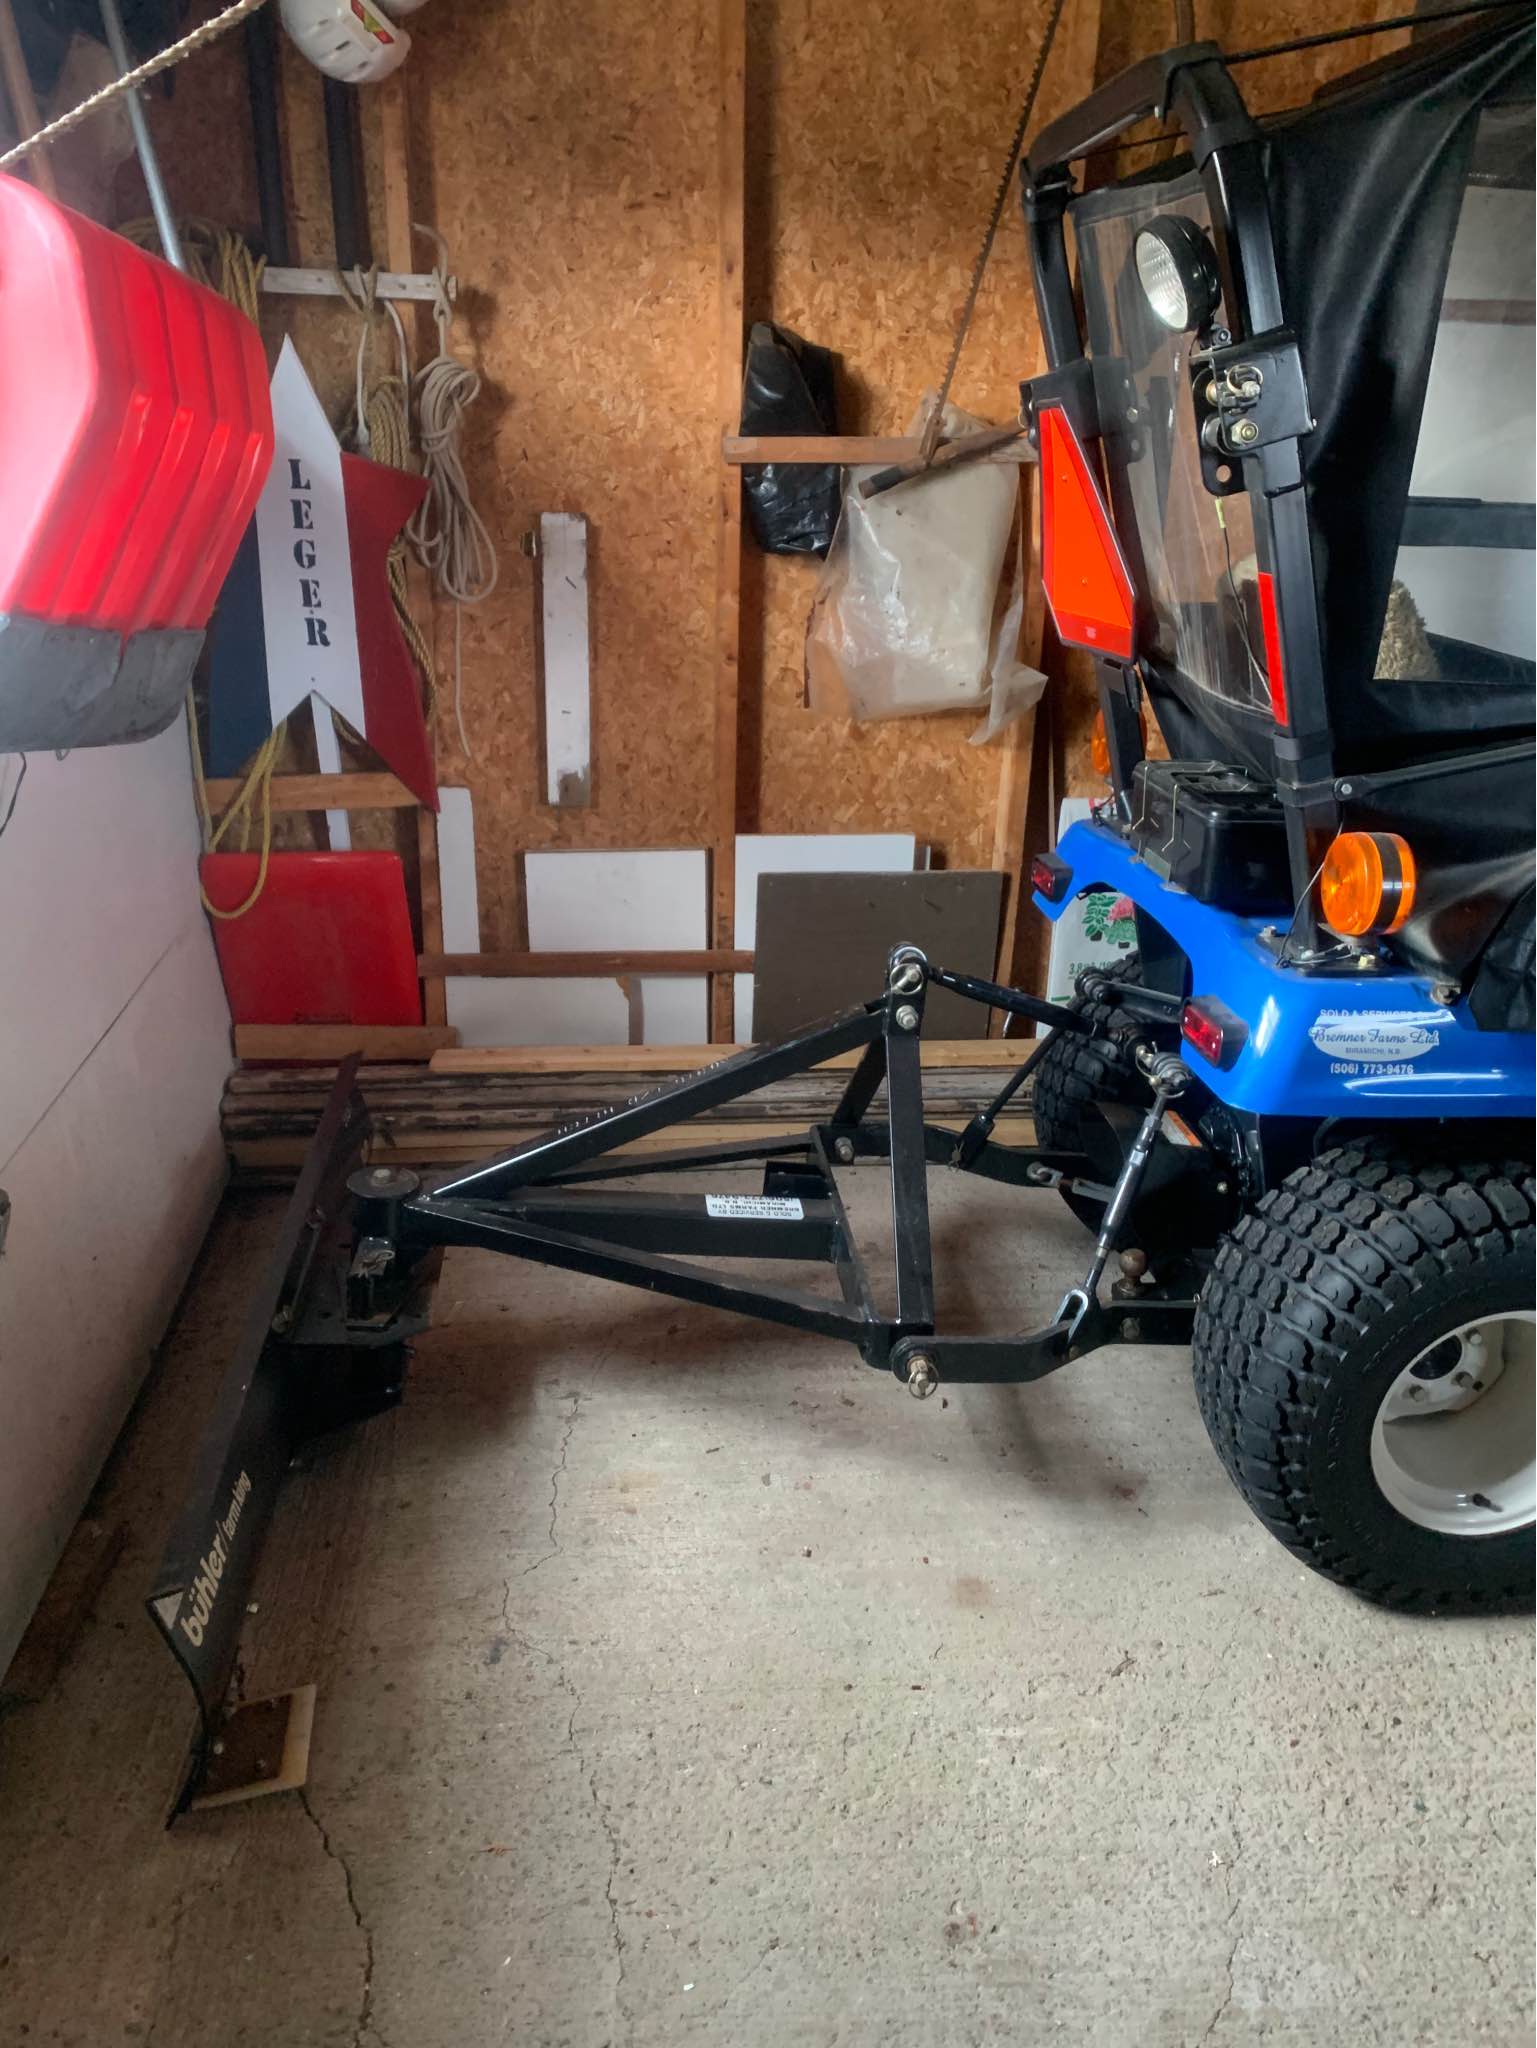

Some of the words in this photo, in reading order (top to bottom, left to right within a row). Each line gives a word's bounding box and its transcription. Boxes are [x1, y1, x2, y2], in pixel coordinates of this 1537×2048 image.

[288, 459, 331, 647] LEGER
[1310, 1028, 1366, 1042] Bremner
[1367, 1028, 1407, 1042] Farms
[1330, 1062, 1359, 1075] (506)
[1363, 1063, 1414, 1076] 773-9476
